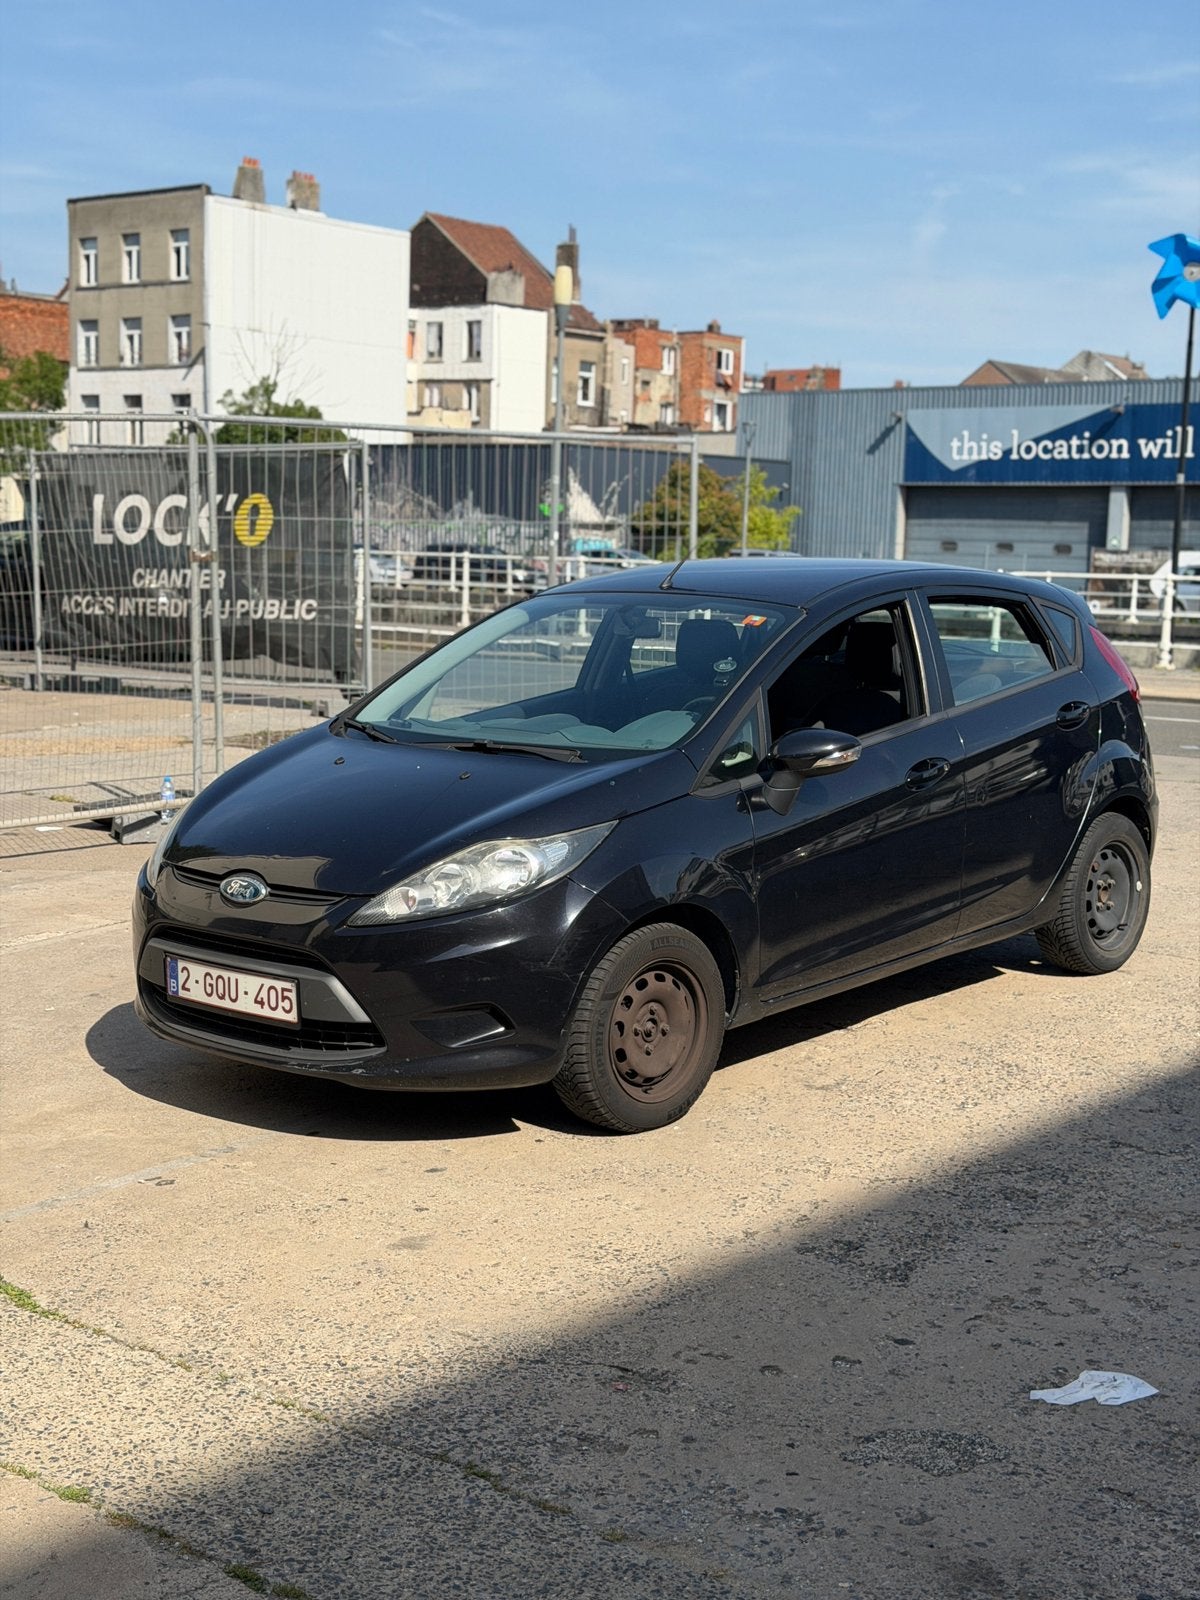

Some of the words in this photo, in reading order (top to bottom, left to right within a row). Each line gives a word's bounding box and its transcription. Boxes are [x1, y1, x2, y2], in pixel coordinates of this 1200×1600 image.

[950, 430, 1003, 461] this
[1010, 429, 1130, 460] location
[1137, 425, 1195, 459] will
[132, 568, 226, 590] CHANTER
[119, 597, 196, 619] INTERDI
[236, 599, 318, 620] PUBLIC
[227, 879, 254, 898] Ford
[170, 979, 178, 992] B
